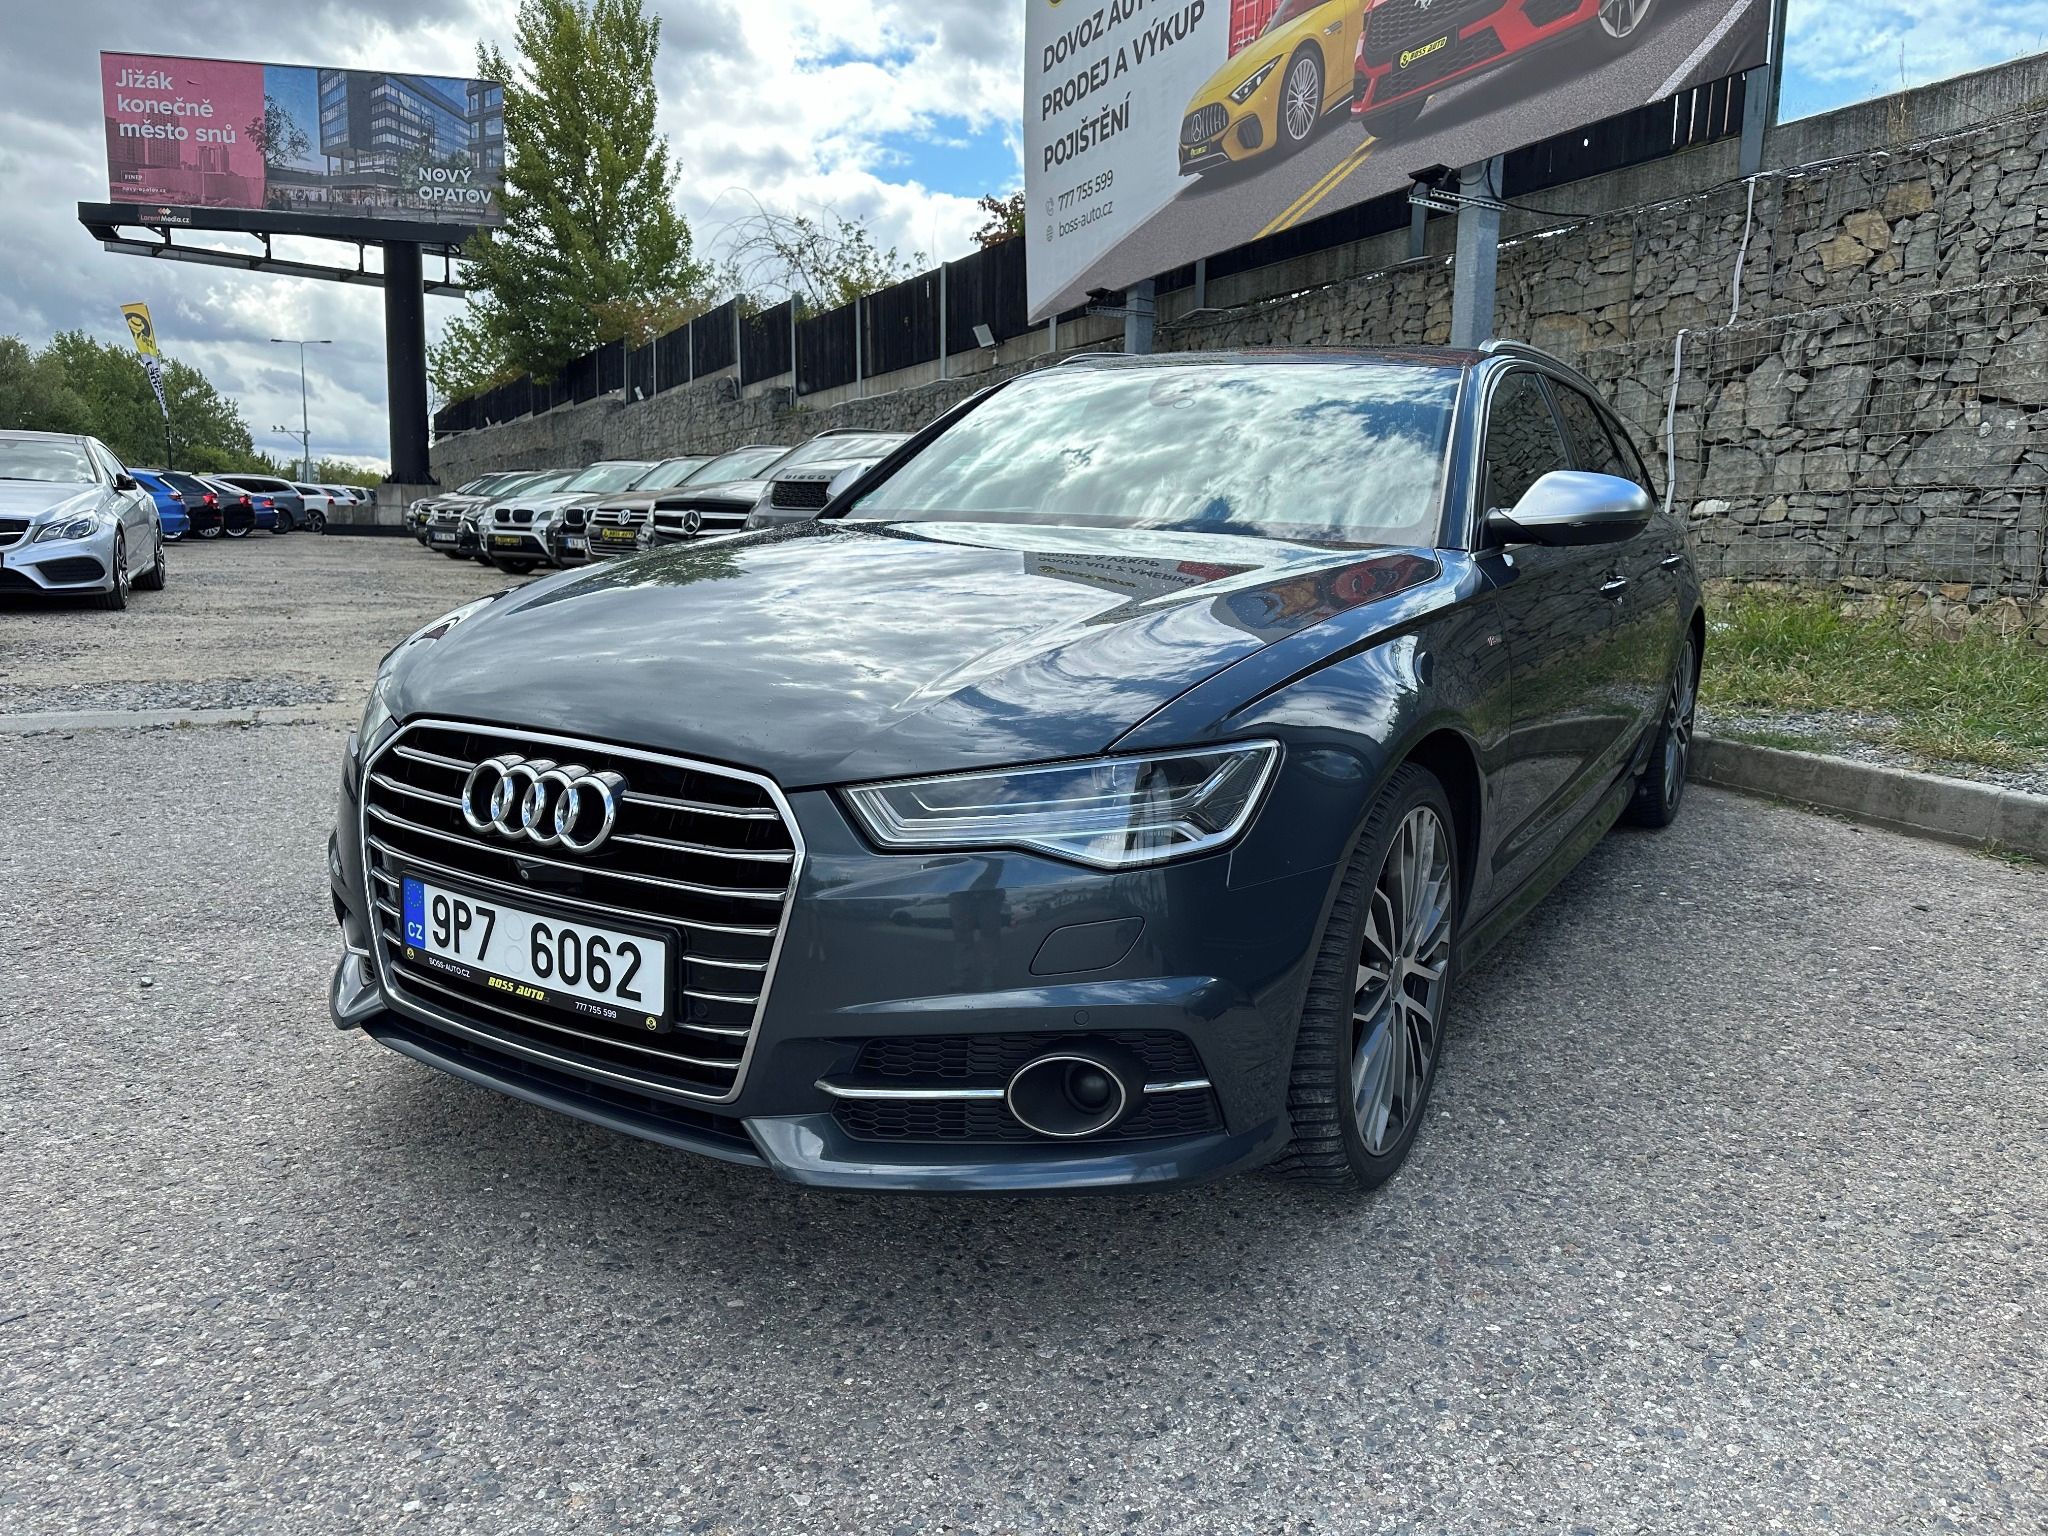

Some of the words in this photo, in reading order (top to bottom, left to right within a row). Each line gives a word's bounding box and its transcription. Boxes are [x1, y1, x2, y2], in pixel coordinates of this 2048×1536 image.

[1043, 9, 1104, 73] DOVOZ
[1042, 56, 1110, 121] PRODEJ
[1113, 47, 1128, 79] A
[1132, 1, 1205, 65] VÝKUP
[116, 69, 174, 90] Jižák
[117, 94, 214, 118] konečně
[119, 119, 189, 141] město
[195, 123, 236, 144] snů
[1044, 91, 1132, 172] POJIŠTĚNÍ
[418, 167, 472, 184] NOVÝ
[419, 186, 492, 204] OPATOV
[1058, 190, 1075, 211] 777
[1076, 180, 1094, 203] 755
[1095, 169, 1114, 193] 599
[1058, 201, 1113, 237] boss-auto.cz
[408, 921, 423, 940] CZ
[432, 894, 496, 961] 9P7
[531, 922, 642, 1002] 6062
[429, 957, 470, 978] BOSS-AUTO.CZ
[488, 976, 513, 991] BOSS
[516, 985, 545, 1001] AUTO
[575, 1001, 587, 1012] 777
[588, 1004, 602, 1015] 755
[603, 1008, 617, 1019] 599
